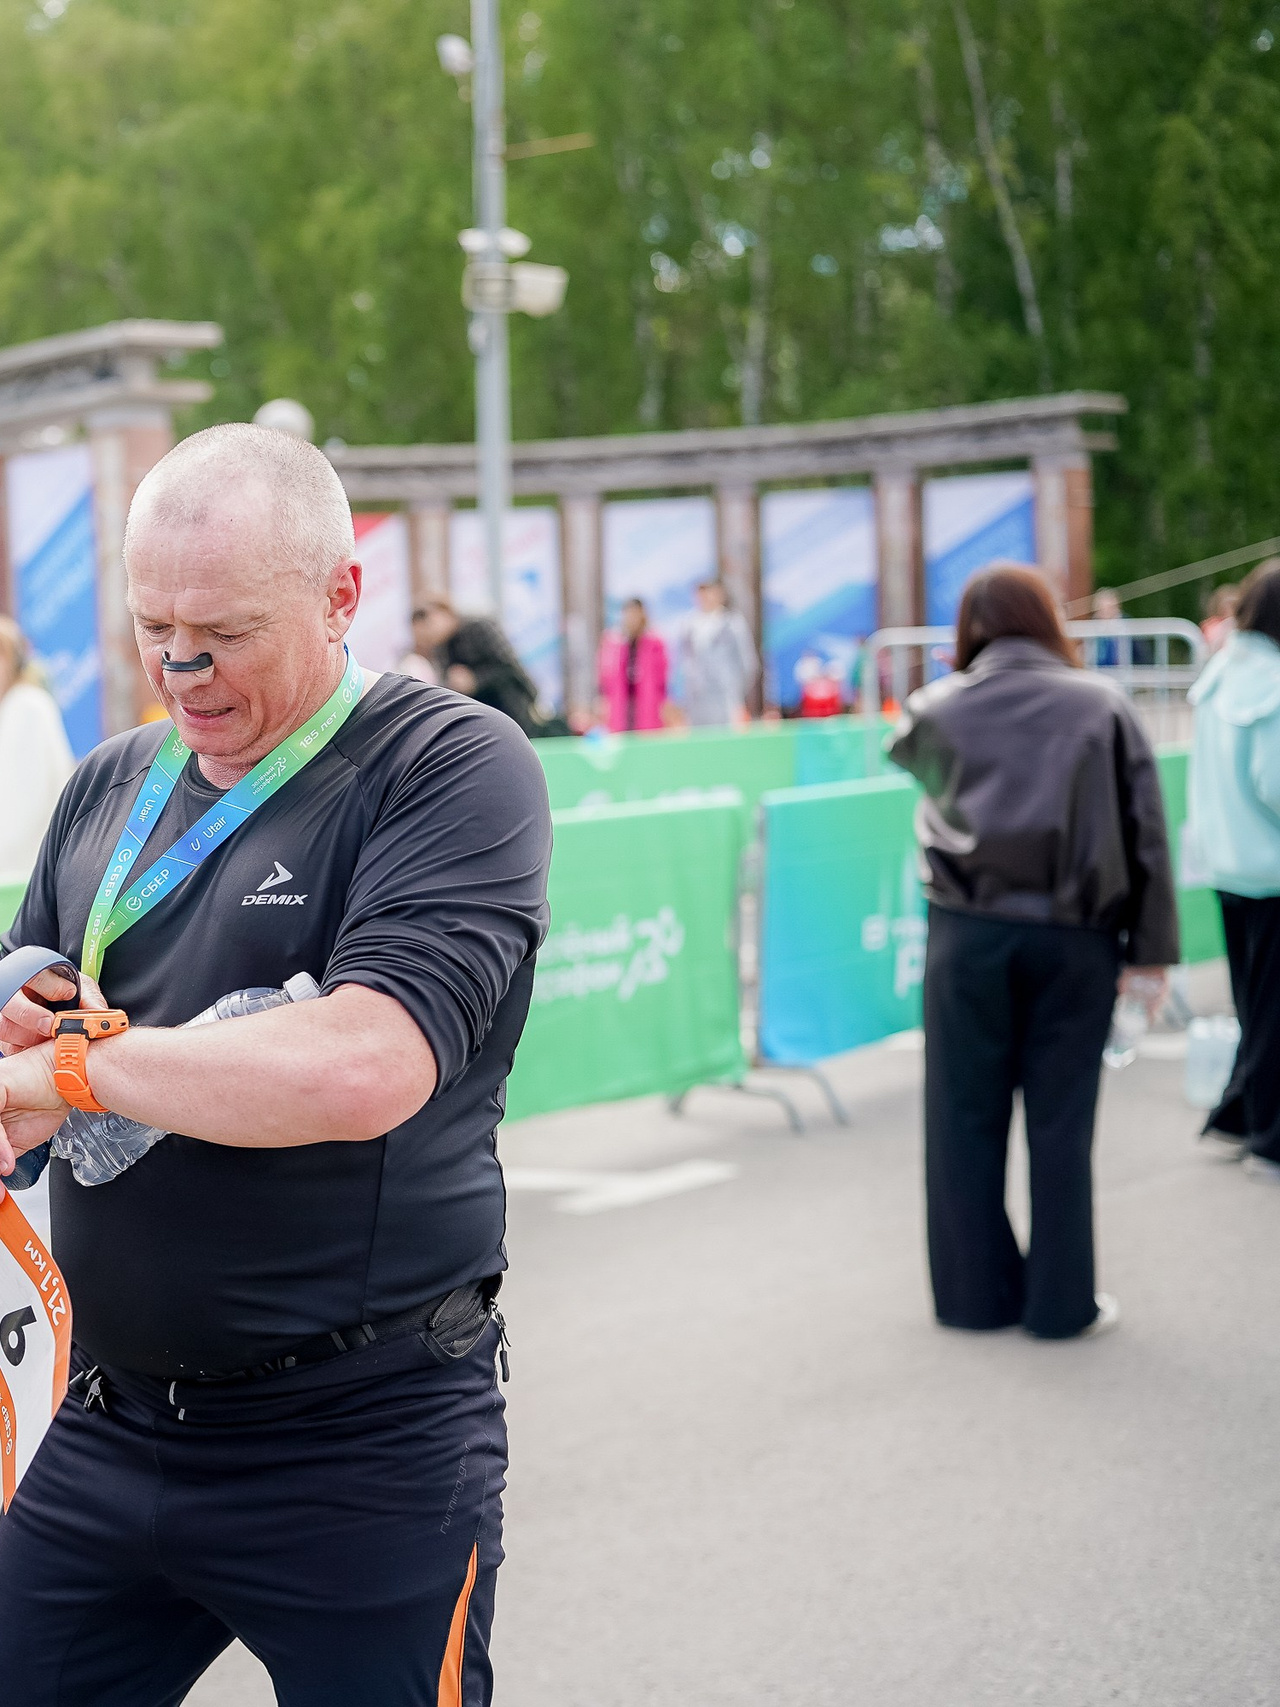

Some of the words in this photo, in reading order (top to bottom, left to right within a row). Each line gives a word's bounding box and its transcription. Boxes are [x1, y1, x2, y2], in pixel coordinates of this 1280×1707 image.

[299, 728, 320, 749] 185
[320, 711, 338, 732] лет
[137, 798, 157, 824] Utair
[202, 815, 228, 839] Utair
[104, 865, 124, 898] СБЕР
[140, 868, 171, 898] СБЕР
[241, 894, 309, 906] DEMIX
[439, 1479, 465, 1535] running
